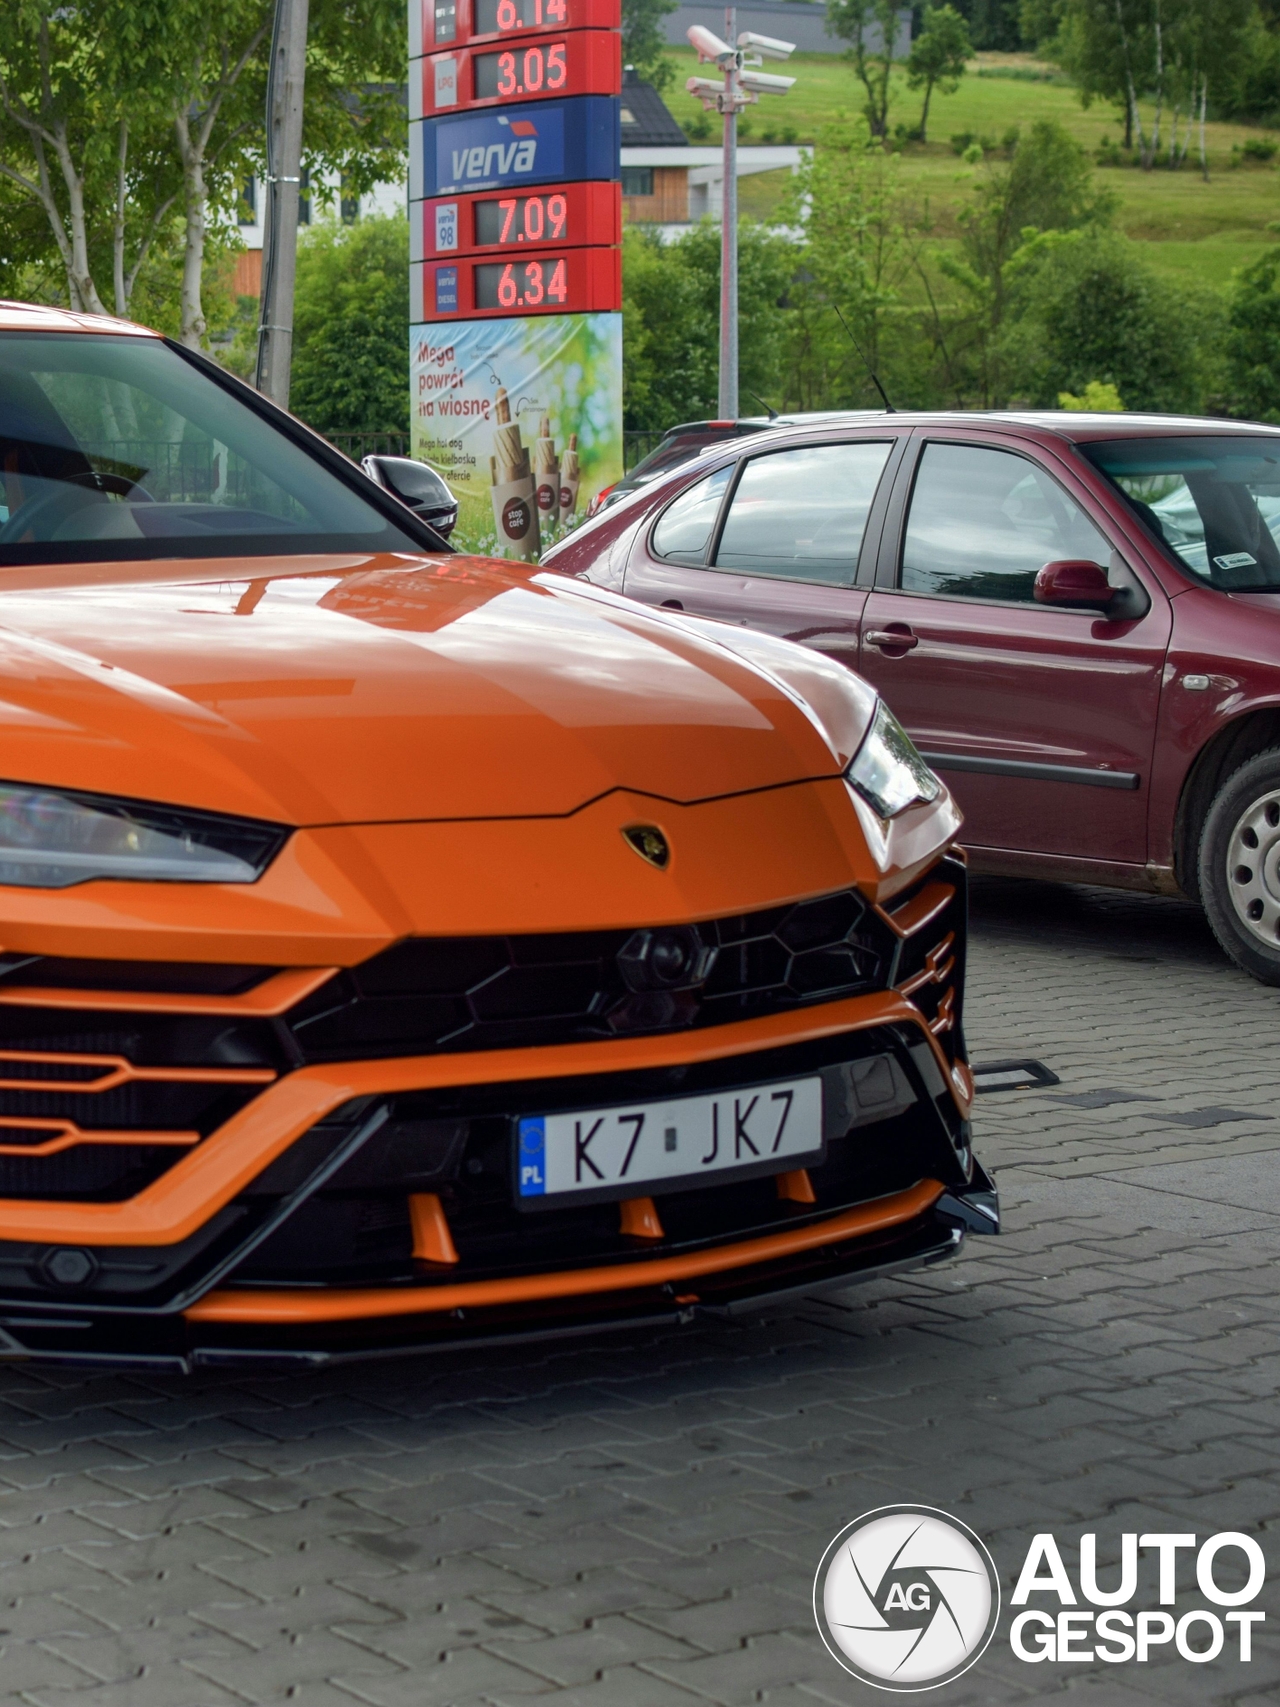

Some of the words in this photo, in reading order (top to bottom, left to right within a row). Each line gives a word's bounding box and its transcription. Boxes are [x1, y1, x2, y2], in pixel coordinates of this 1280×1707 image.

[498, 43, 567, 95] 3.05
[438, 76, 454, 91] LPG
[452, 140, 537, 180] verva
[499, 194, 567, 243] 7.09
[440, 226, 454, 246] 98
[498, 259, 567, 307] 6.34
[438, 295, 456, 304] DIESEL
[418, 342, 454, 368] Mega
[419, 401, 434, 416] na
[438, 394, 491, 420] wiosnę
[449, 439, 463, 451] dog
[447, 470, 471, 481] ofercie
[508, 509, 523, 520] stop
[509, 518, 524, 528] cafe
[575, 1113, 646, 1184] K7
[701, 1089, 794, 1165] JK7
[521, 1165, 543, 1186] PL
